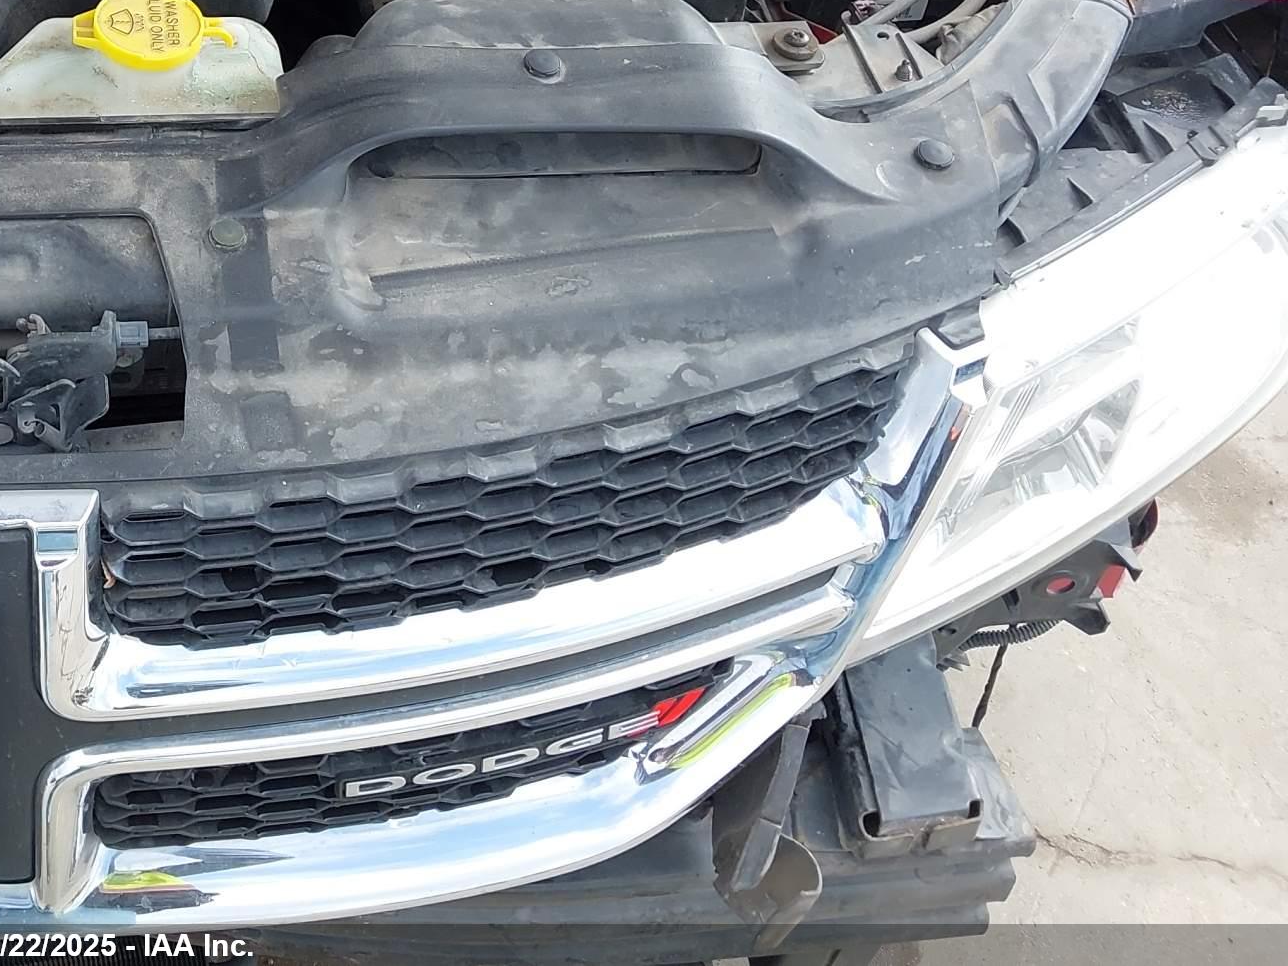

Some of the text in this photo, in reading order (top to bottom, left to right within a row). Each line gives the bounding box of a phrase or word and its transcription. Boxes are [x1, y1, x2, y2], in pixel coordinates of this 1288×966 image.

[150, 25, 165, 53] ONLY
[165, 0, 181, 46] WASHER
[345, 709, 661, 798] DODGE
